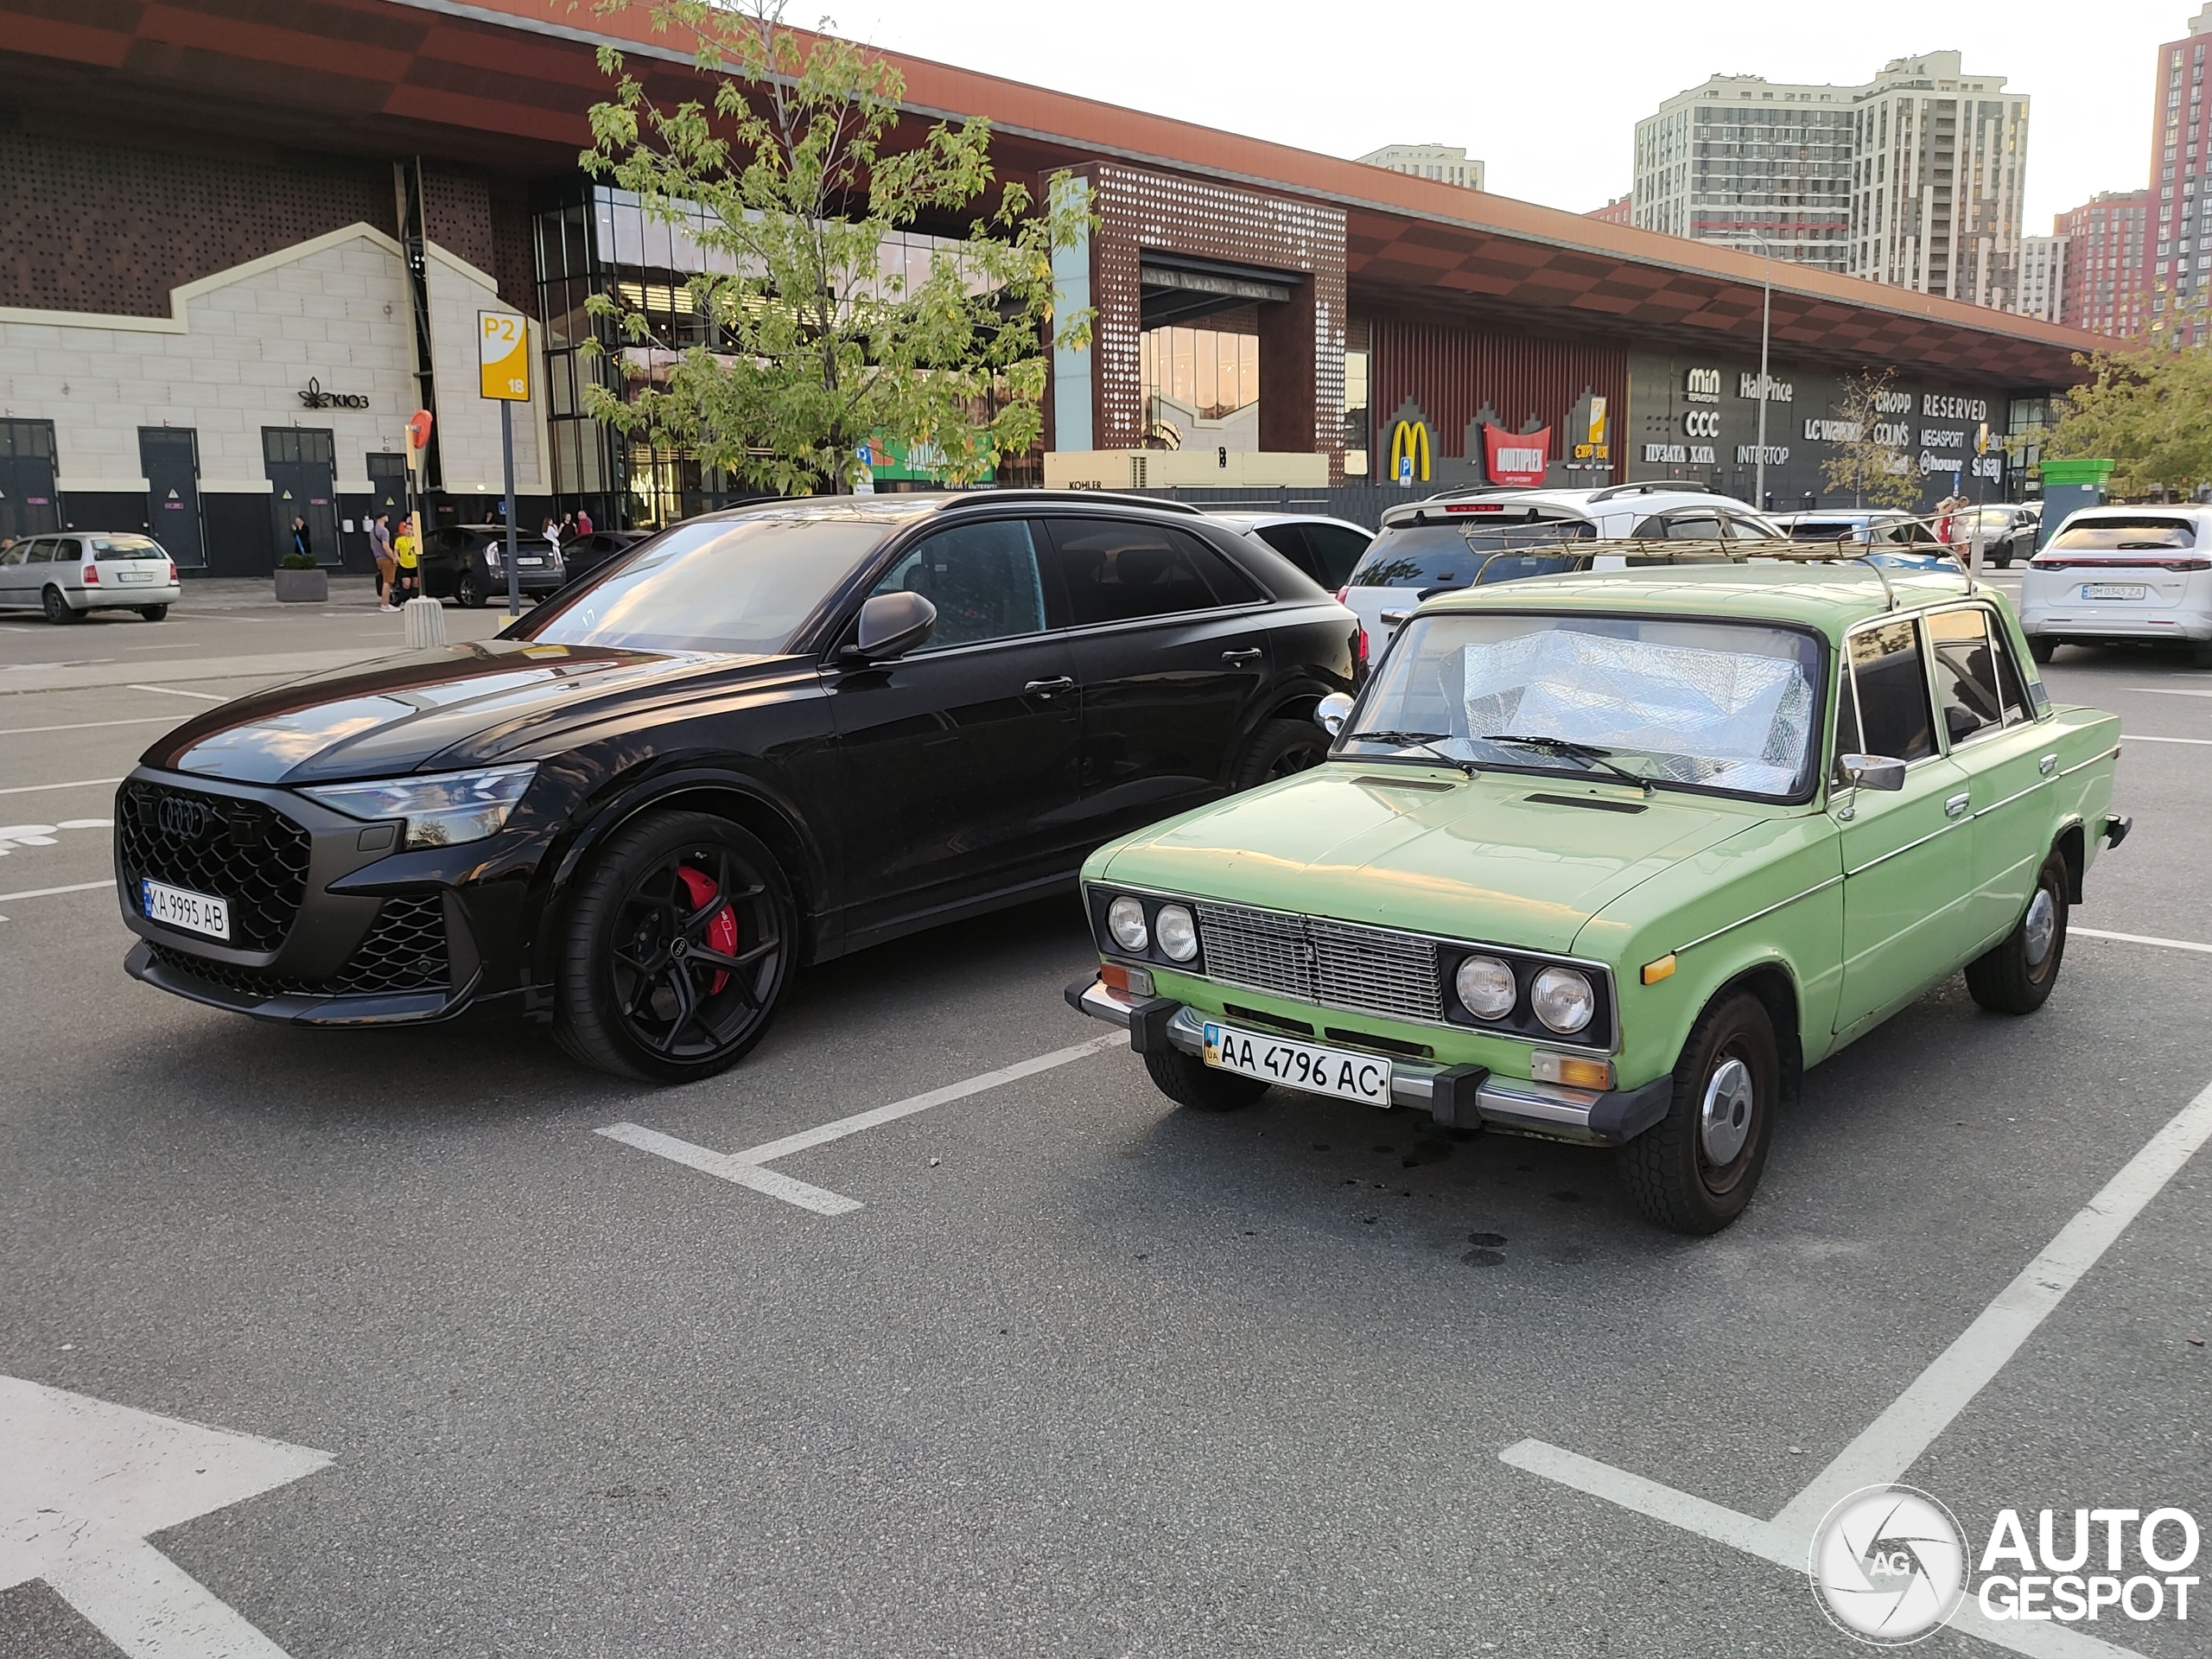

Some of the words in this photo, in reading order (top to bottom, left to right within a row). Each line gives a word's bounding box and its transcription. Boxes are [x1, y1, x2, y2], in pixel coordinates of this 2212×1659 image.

[484, 317, 515, 341] P2
[507, 378, 524, 394] 18
[1739, 372, 1792, 402] HalPrice
[1875, 391, 1911, 414] CROPP
[1923, 394, 1986, 421] RESERVED
[1686, 410, 1719, 437] CCC
[1804, 419, 1821, 441] LC
[1873, 421, 1909, 447] COLIN'S
[1920, 429, 1964, 448] MEGASPORT
[1497, 448, 1543, 473] MULTIPLEX
[1644, 443, 1686, 463] ПУЗАТА
[1688, 445, 1715, 464] ХАТА
[1738, 444, 1789, 466] INTERTOP
[1069, 480, 1102, 491] KOHLER
[2088, 588, 2103, 596] BM
[149, 888, 168, 918] KA
[170, 894, 199, 925] 9995
[205, 904, 223, 931] AB
[1207, 1049, 1218, 1061] UA
[1222, 1035, 1256, 1071] AA
[1264, 1046, 1327, 1086] 4796
[1338, 1060, 1378, 1096] AC
